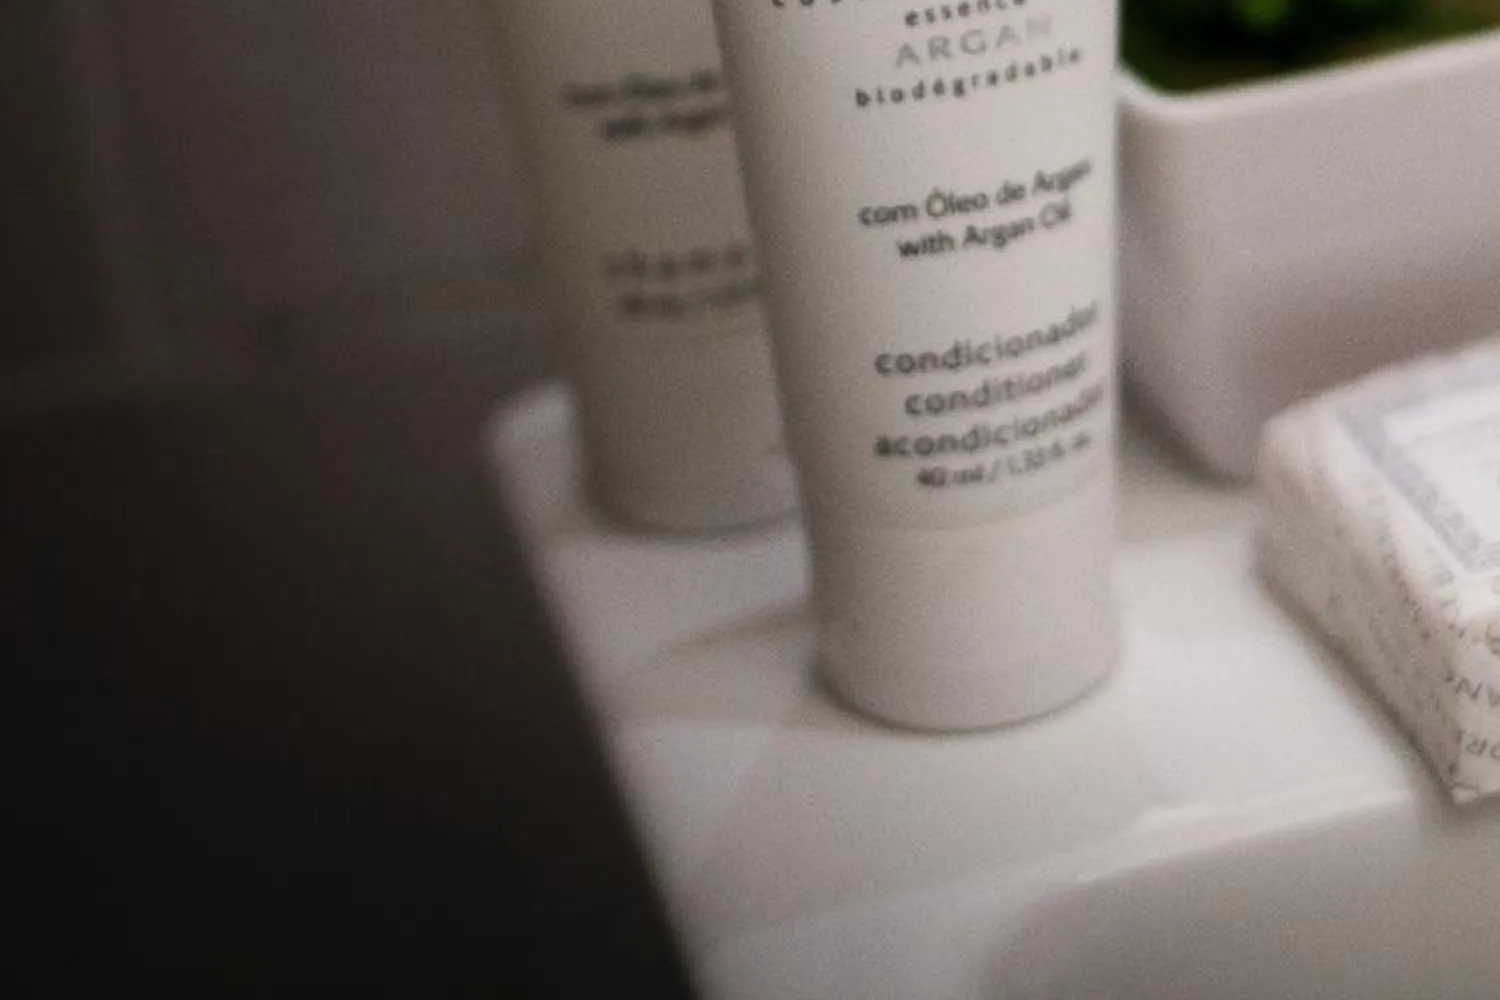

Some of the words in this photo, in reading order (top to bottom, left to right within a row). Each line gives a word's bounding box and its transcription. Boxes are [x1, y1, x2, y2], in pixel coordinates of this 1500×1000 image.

[894, 14, 1055, 69] ARGAN
[855, 47, 1082, 109] biodégradable
[858, 203, 918, 226] com
[996, 180, 1026, 205] de
[897, 229, 955, 257] with
[961, 215, 1036, 250] Argan
[904, 351, 1087, 416] conditioner
